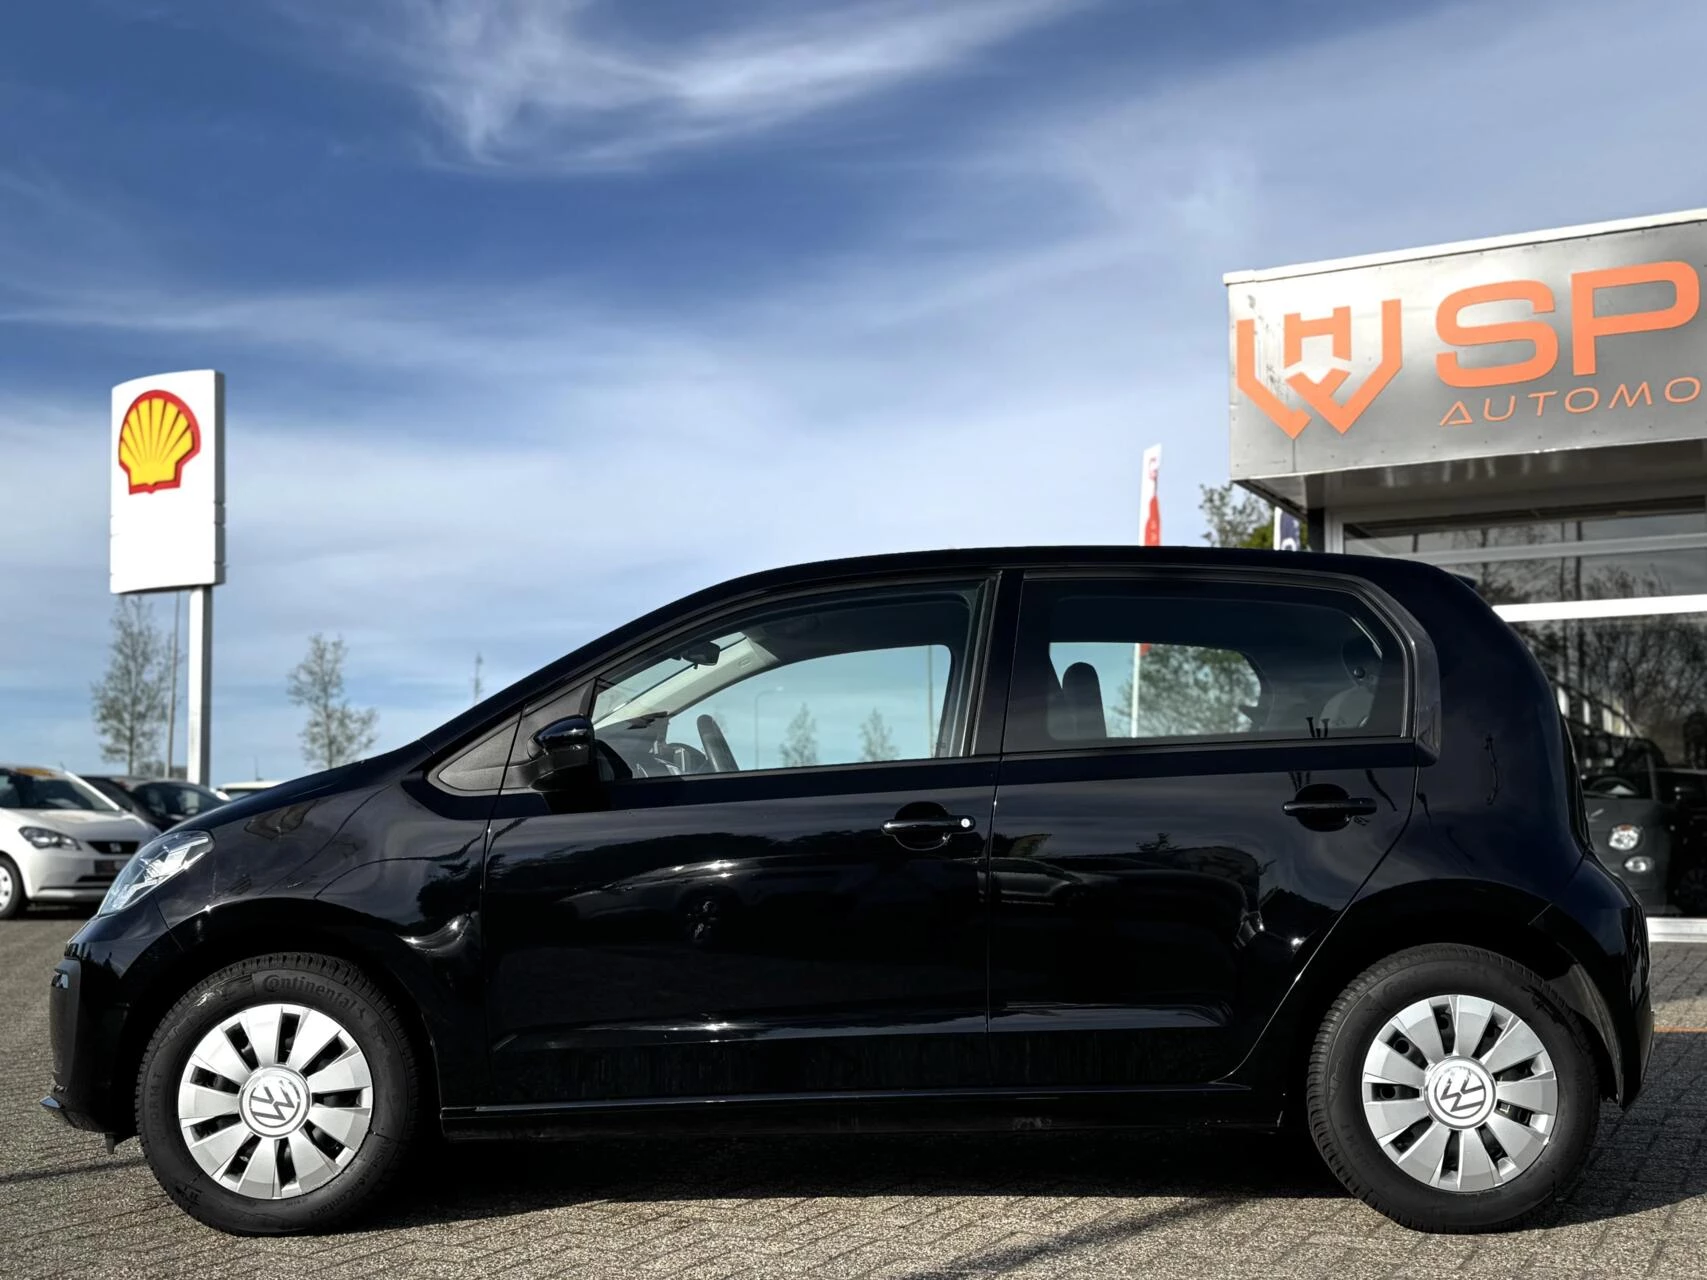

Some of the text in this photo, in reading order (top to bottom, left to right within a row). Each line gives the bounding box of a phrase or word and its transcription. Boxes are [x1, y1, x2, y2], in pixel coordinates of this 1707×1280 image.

[1435, 261, 1700, 388] SP
[1440, 376, 1701, 427] AUTOMO
[263, 974, 358, 1010] Continental
